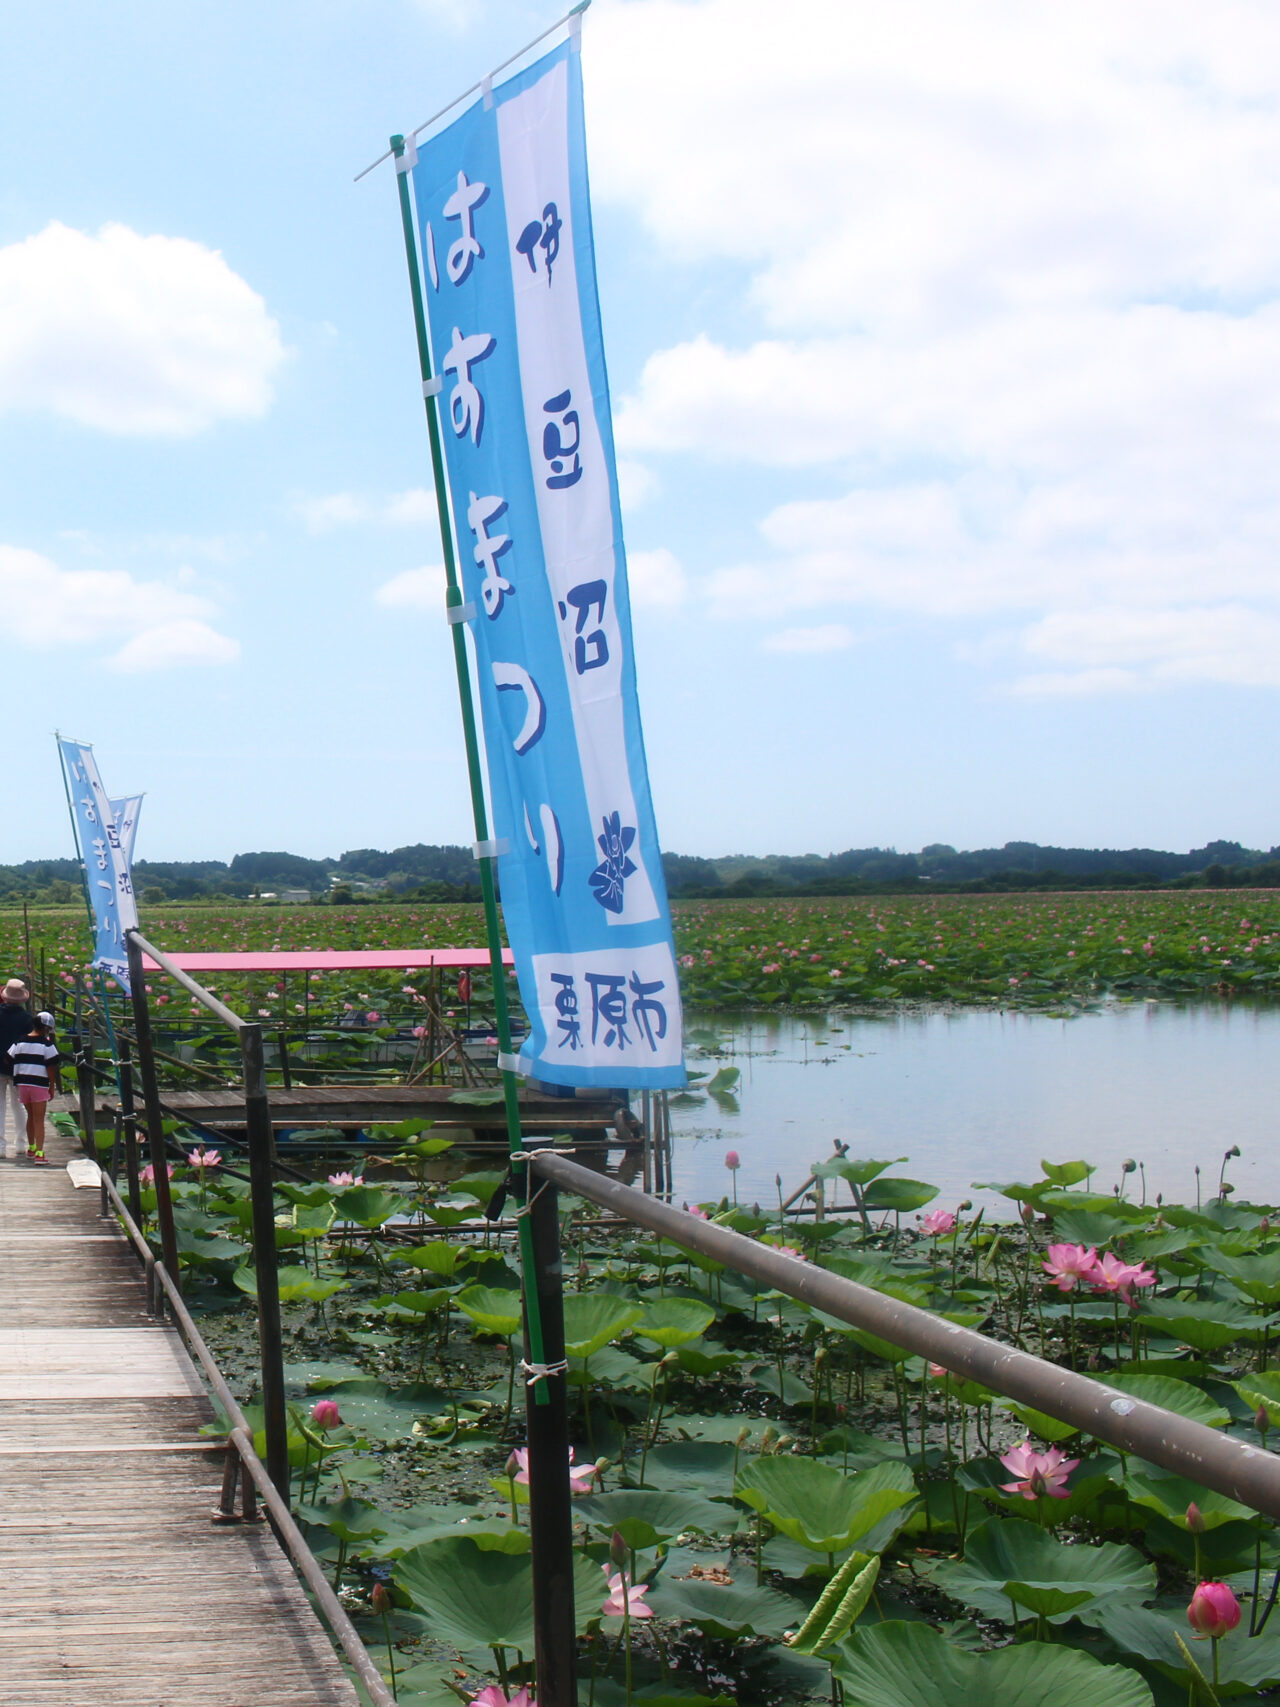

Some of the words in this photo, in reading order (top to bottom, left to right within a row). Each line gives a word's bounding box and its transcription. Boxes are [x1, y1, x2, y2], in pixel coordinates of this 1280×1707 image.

[426, 170, 564, 898] はすまつり
[516, 202, 609, 675] 伊豆沼
[550, 970, 668, 1052] 栗原市
